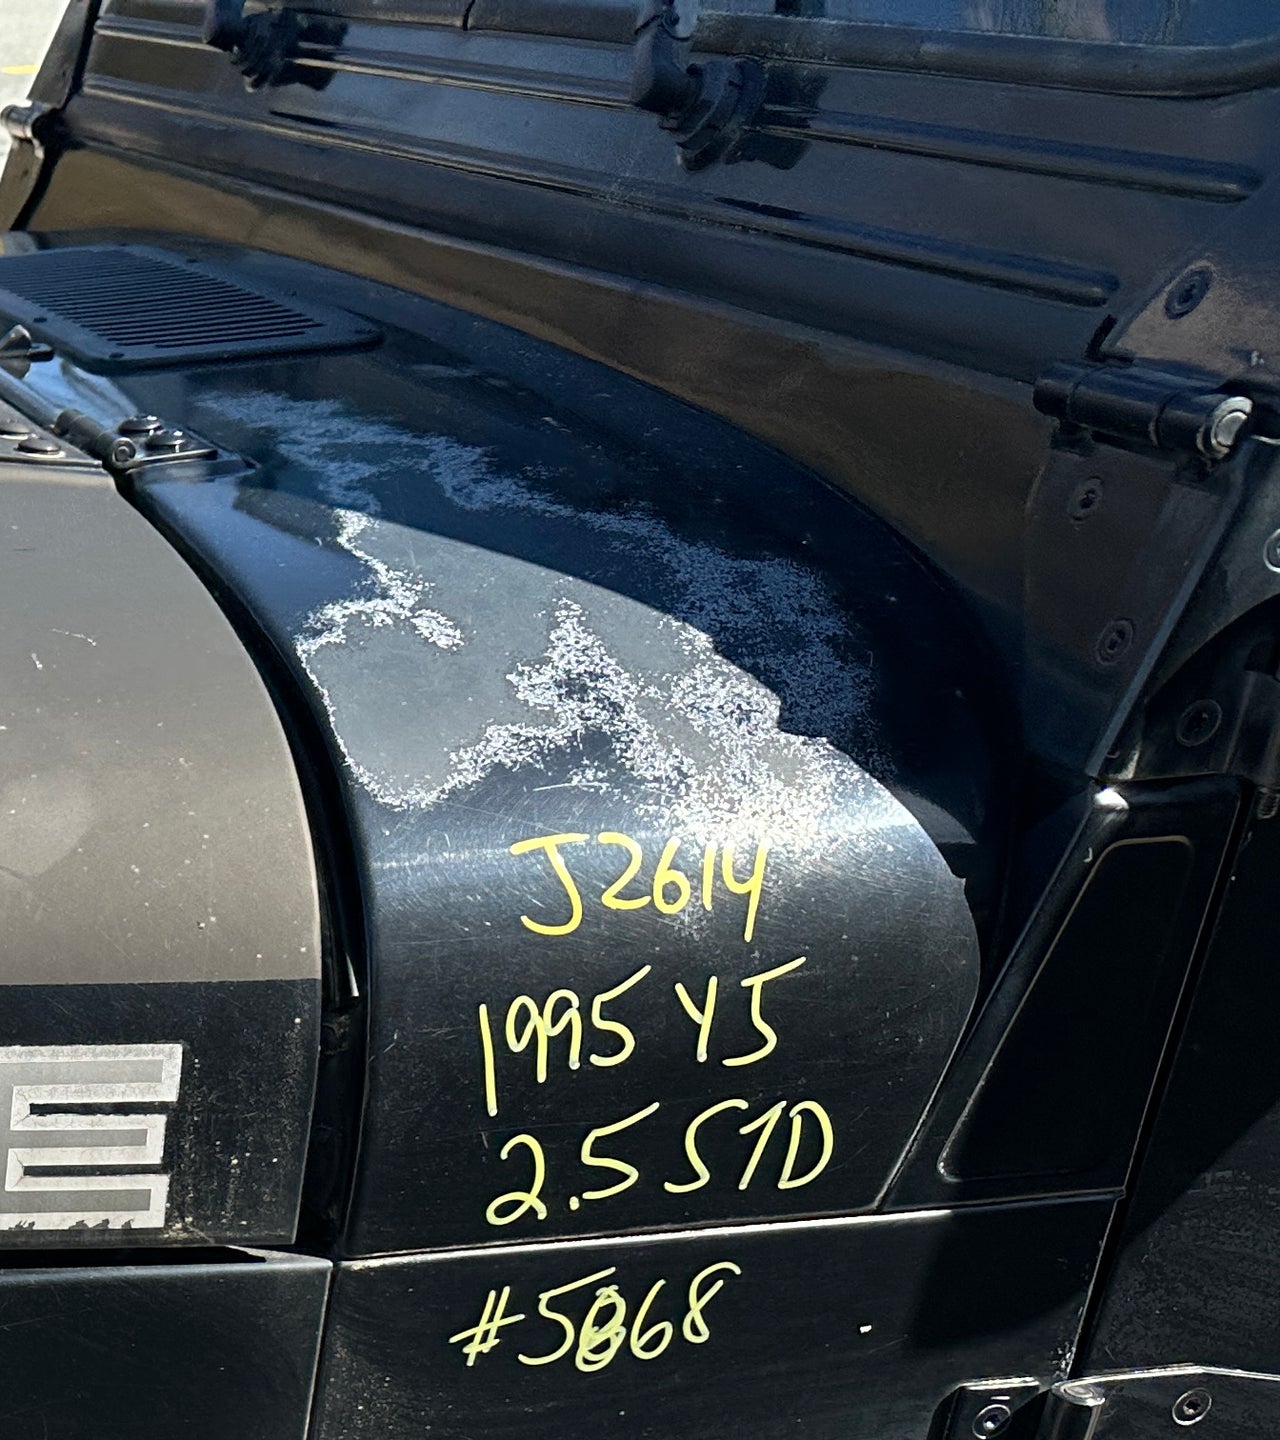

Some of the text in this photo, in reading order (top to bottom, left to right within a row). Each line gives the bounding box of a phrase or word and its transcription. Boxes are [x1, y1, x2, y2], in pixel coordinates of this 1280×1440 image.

[510, 831, 774, 942] J2614
[478, 964, 652, 1117] 1995
[486, 1099, 835, 1226] 2.5 STD
